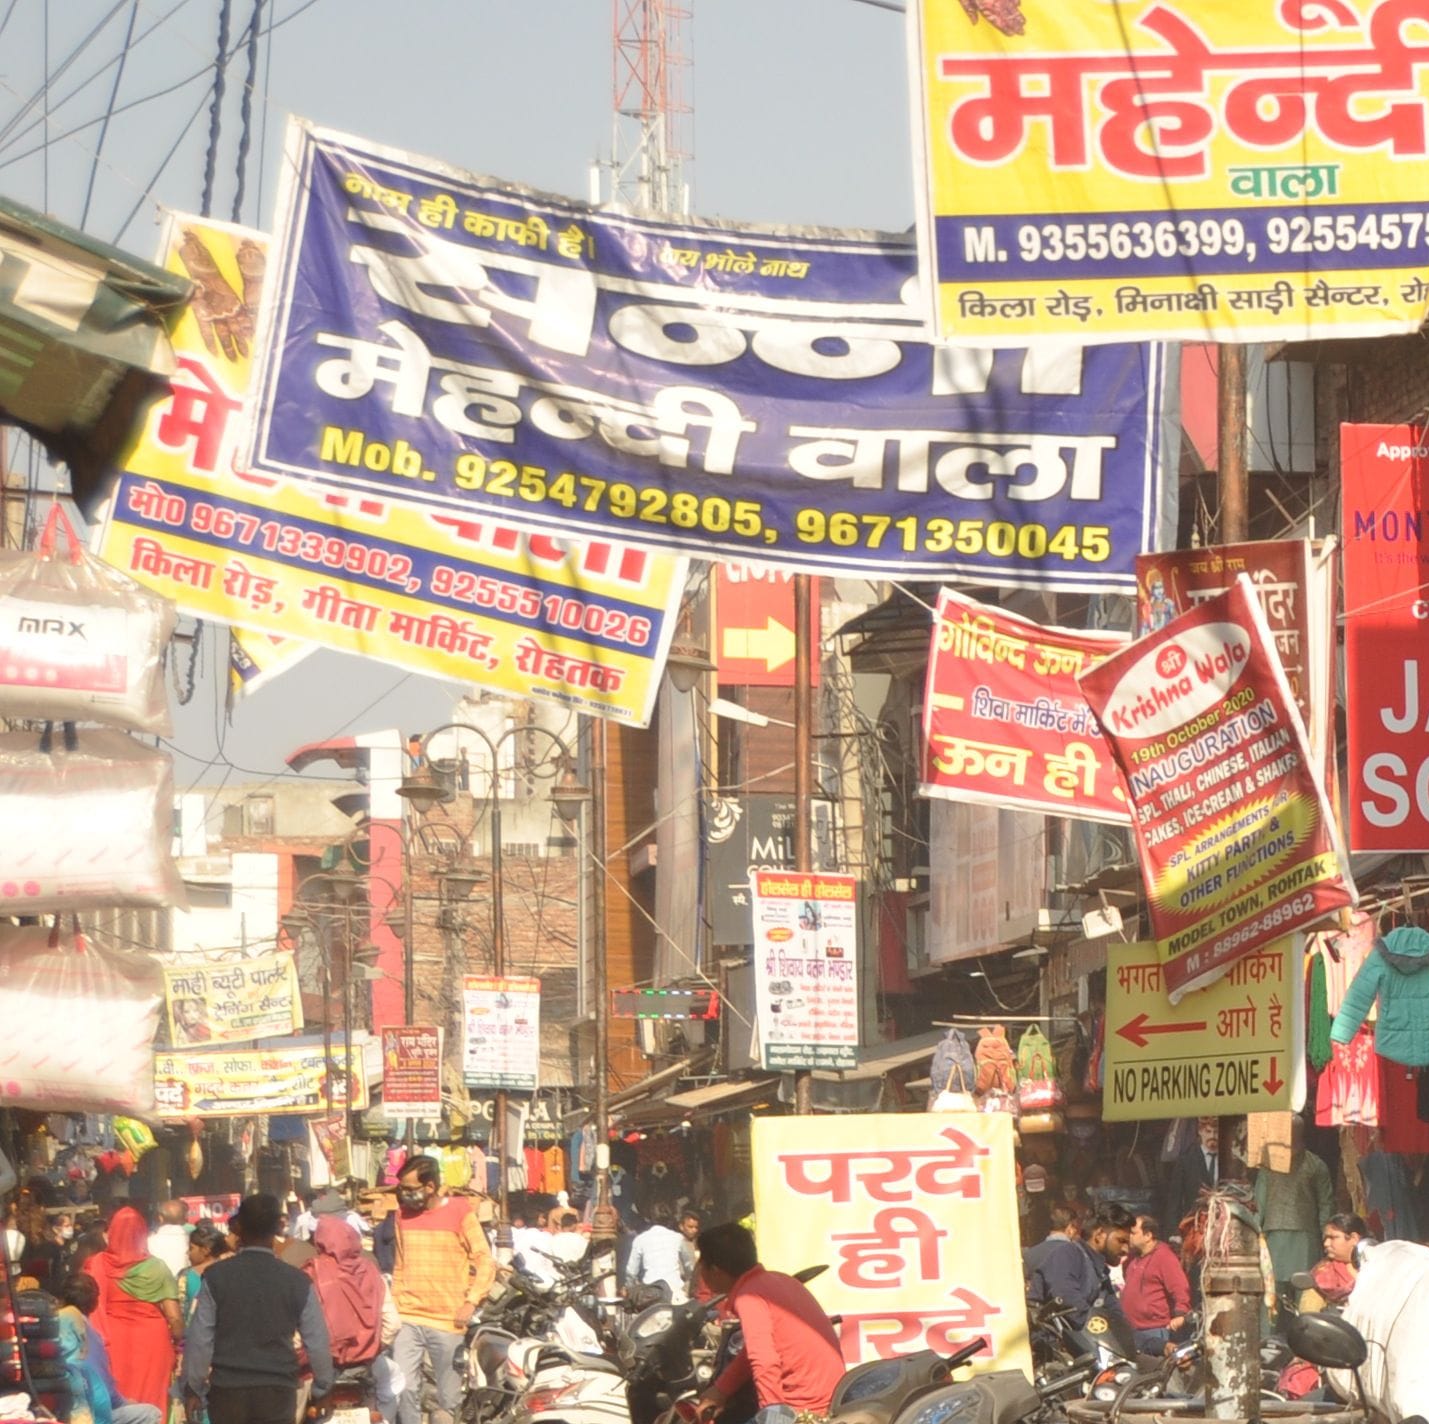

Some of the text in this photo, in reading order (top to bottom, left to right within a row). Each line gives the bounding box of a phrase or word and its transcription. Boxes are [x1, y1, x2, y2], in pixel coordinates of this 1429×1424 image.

[343, 171, 413, 213] नाम
[416, 192, 460, 230] ही
[463, 208, 552, 251] काफी
[1228, 162, 1340, 199] वाला
[703, 244, 757, 275] भोले
[759, 256, 811, 281] नाथ
[963, 226, 1008, 263] M.
[1017, 219, 1256, 263] 9355636399,
[958, 288, 1037, 320] किला
[1115, 278, 1219, 317] मिनाक्षी
[1228, 279, 1294, 320] साड़ी
[320, 426, 437, 482] Mob.
[454, 451, 779, 543] 9254792805,
[796, 508, 1112, 562] 9671350045
[788, 427, 1117, 501] वाला
[129, 536, 214, 588] किला
[303, 583, 380, 636] गीता
[515, 634, 627, 695] रोहतक
[431, 566, 652, 647] 9255510026
[1111, 676, 1194, 731] Krishna
[1194, 641, 1247, 684] Wala
[1130, 687, 1256, 766] 19th October 2020
[1130, 698, 1276, 797] INAUGURATION
[932, 733, 1102, 798] ऊन ही
[1161, 785, 1197, 820] THALI,
[1197, 757, 1249, 801] CHINESE,
[1249, 728, 1292, 775] ITALIAN
[1144, 819, 1185, 849] CAKES,
[1184, 781, 1245, 830] ICE-CREAM
[1187, 852, 1221, 882] KITTY
[1269, 816, 1280, 833] &
[1194, 805, 1271, 857] ARRANGEMENTS
[1180, 831, 1295, 908] OTHER FUNCTIONS
[1168, 861, 1328, 957] MODEL TOWN, ROHTAK
[1212, 892, 1317, 958] 88962-88962
[1116, 962, 1162, 994] भगत
[1216, 992, 1284, 1039] आगे है
[1113, 1059, 1260, 1104] NO PARKING ZONE
[778, 1127, 993, 1204] परदे
[830, 1206, 949, 1291] ही
[840, 1287, 1002, 1363] रदे
